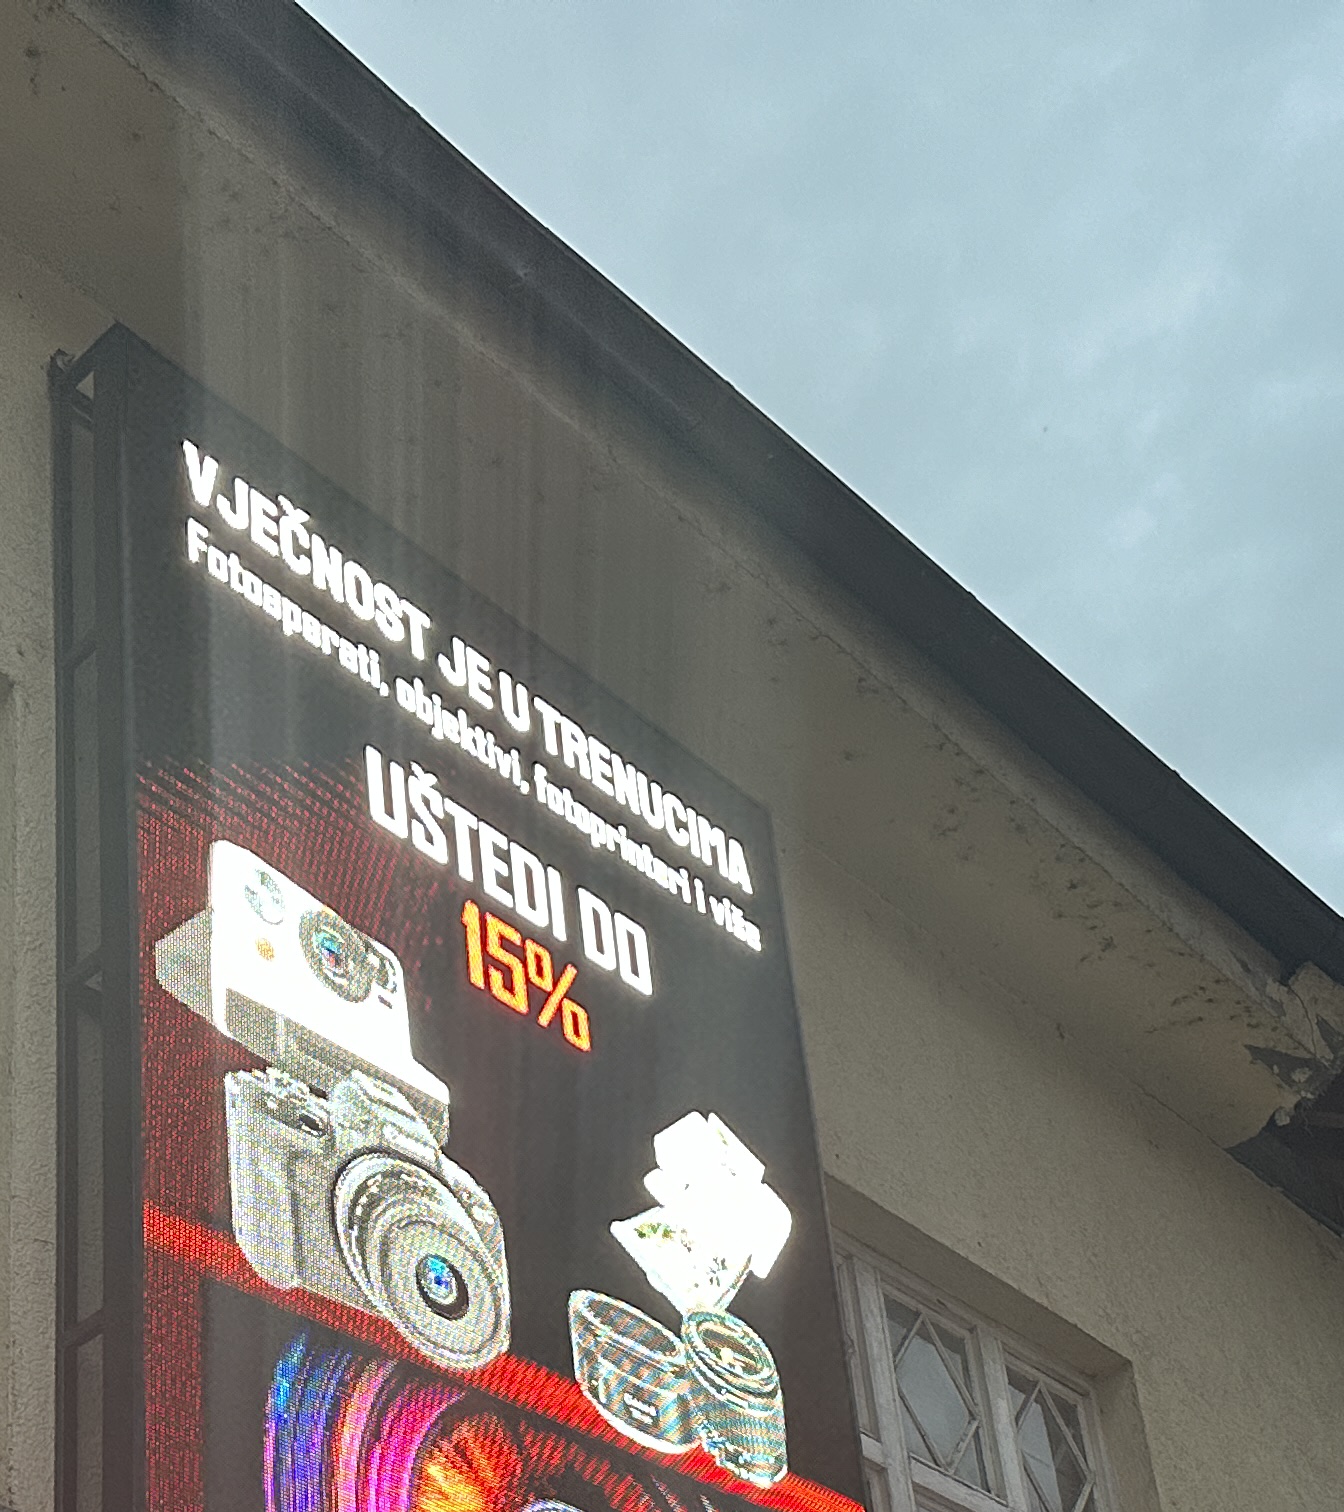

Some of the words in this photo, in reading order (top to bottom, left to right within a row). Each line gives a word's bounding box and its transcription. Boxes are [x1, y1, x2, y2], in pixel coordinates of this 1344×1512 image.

[182, 438, 432, 662] VJEČNOST
[435, 634, 495, 711] JE
[498, 669, 532, 733] U
[533, 695, 754, 896] TRENUCIMA
[186, 516, 391, 698] Fotoaparati,
[395, 676, 531, 795] objektivi,
[532, 762, 692, 905] fotoprinteri
[692, 876, 707, 914] i
[364, 745, 569, 942] UŠTEDI
[577, 886, 654, 997] DO
[460, 899, 592, 1053] 15%
